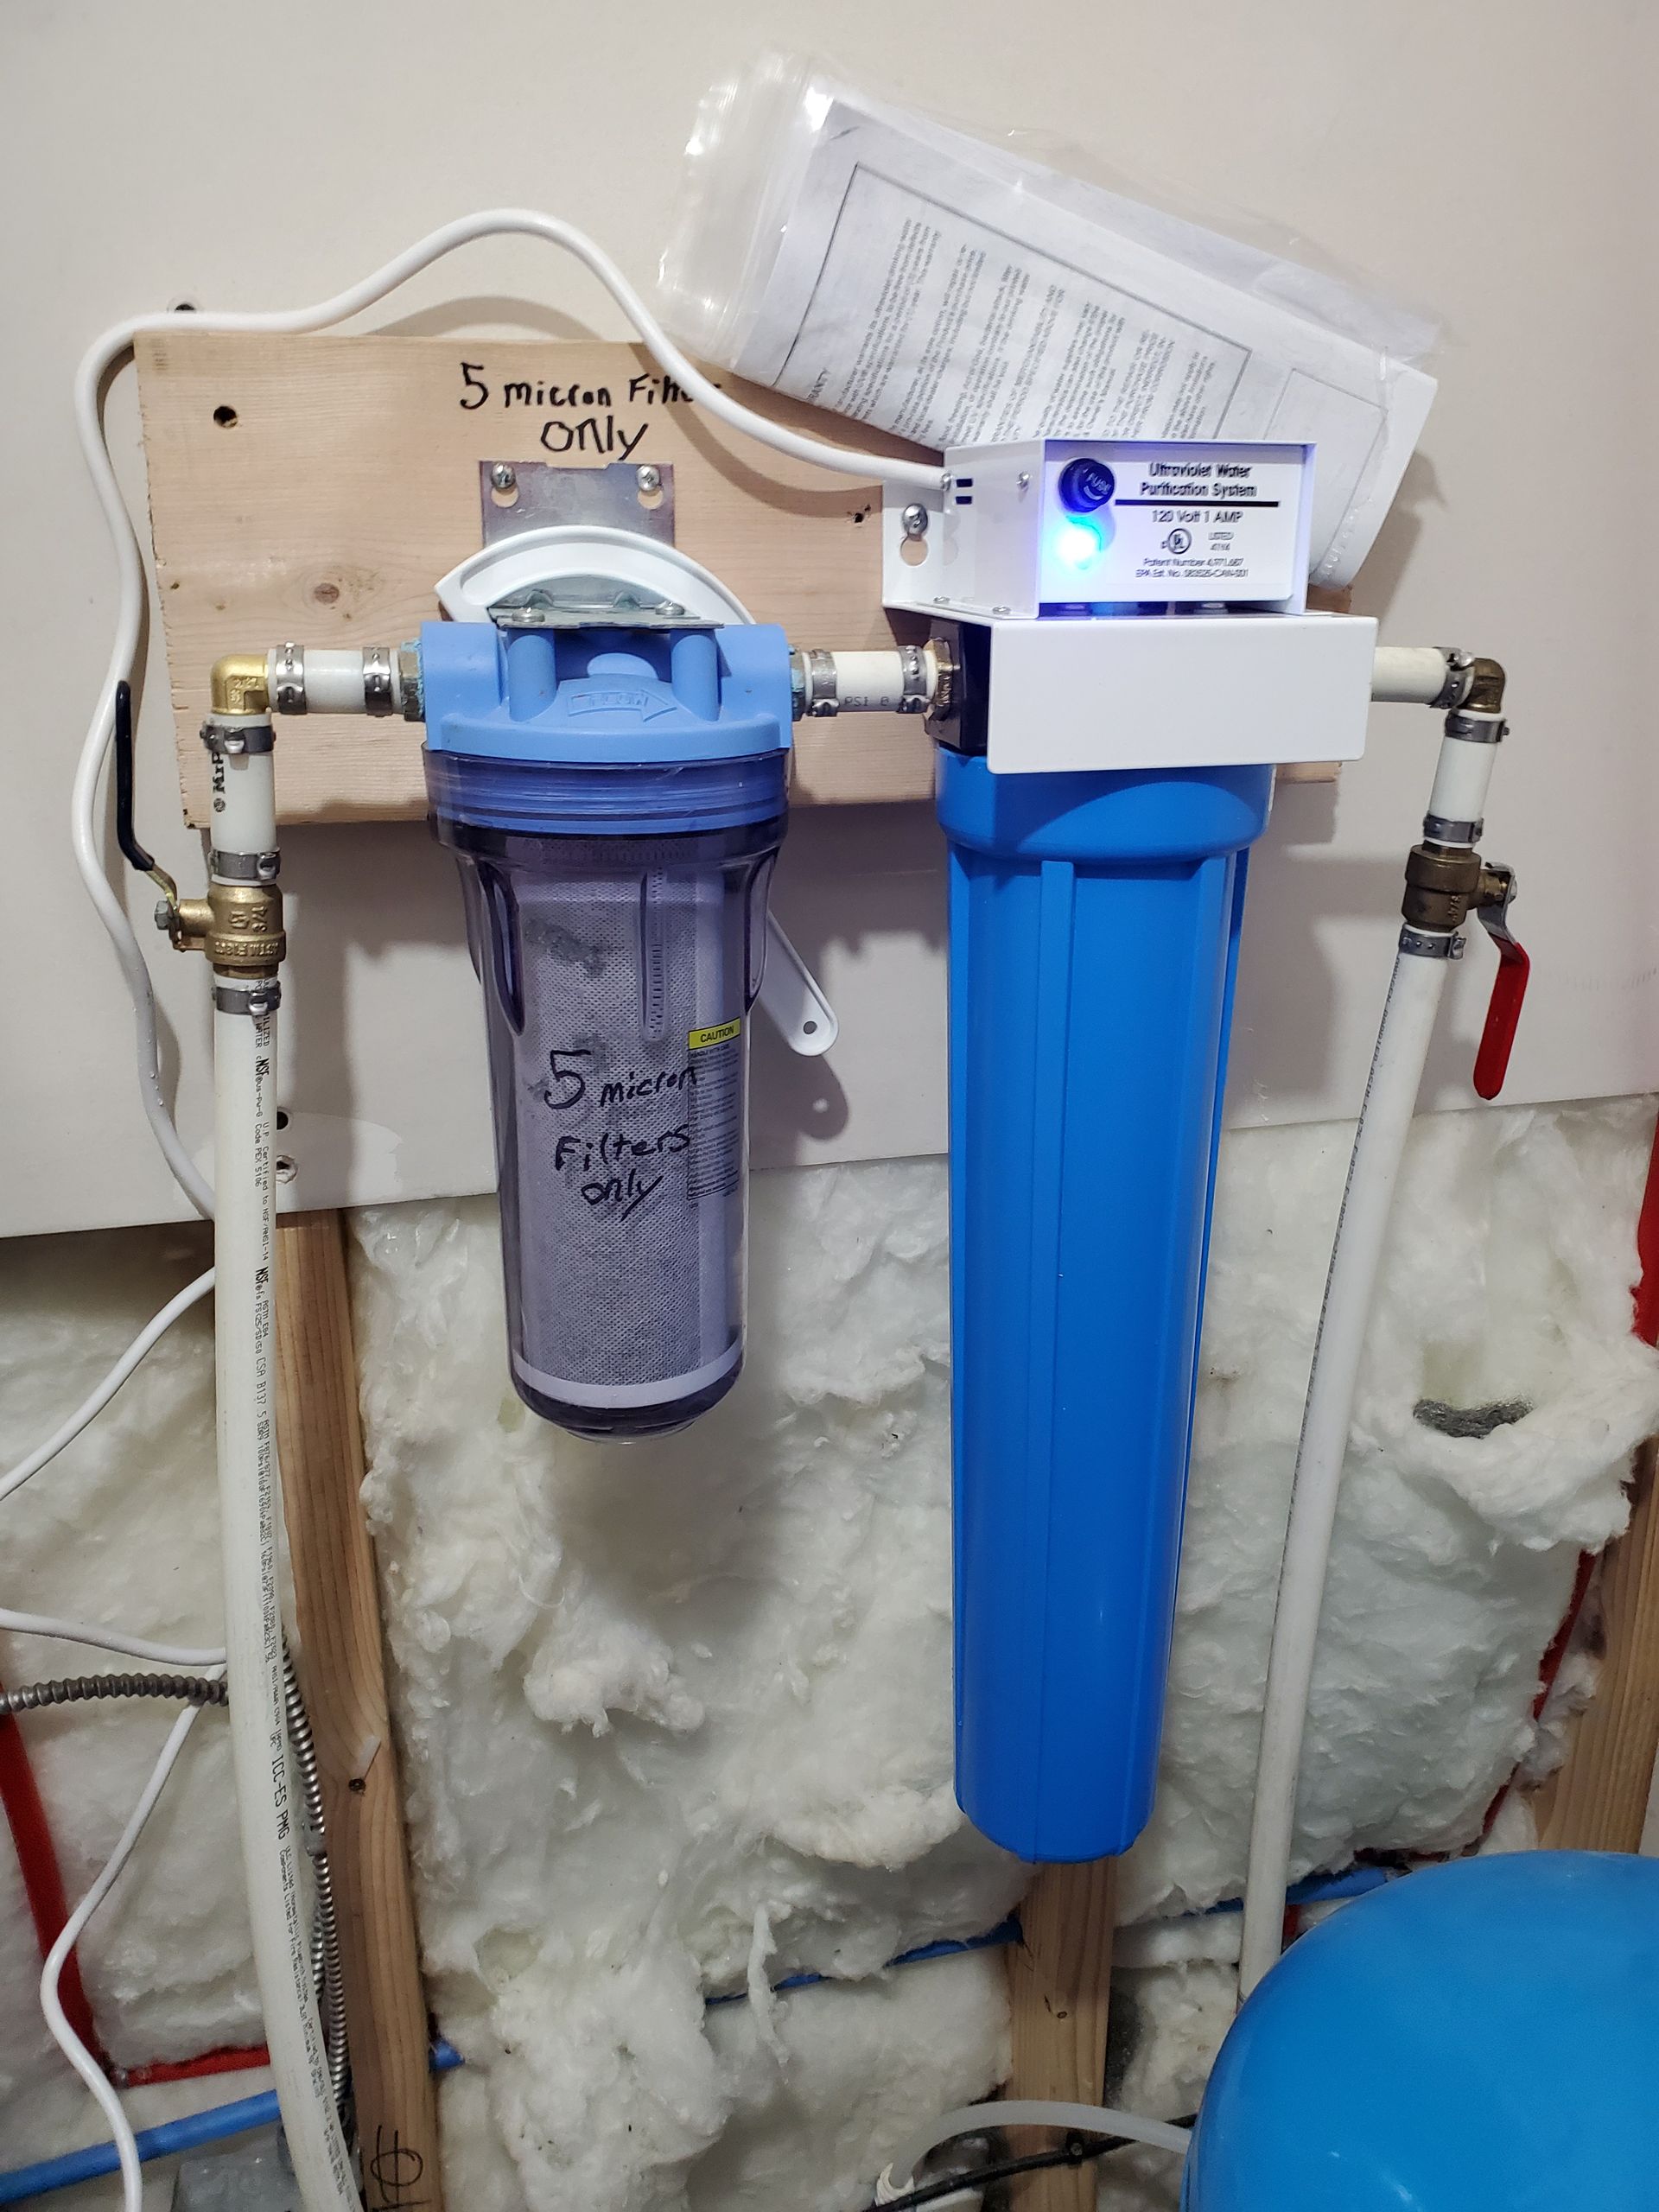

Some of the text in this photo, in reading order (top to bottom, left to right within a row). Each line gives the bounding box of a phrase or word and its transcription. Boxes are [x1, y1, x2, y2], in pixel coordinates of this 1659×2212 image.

[461, 363, 490, 410] 5
[505, 380, 611, 408] micron
[1148, 463, 1251, 478] Ultraviolet Water
[1141, 482, 1257, 499] Purification System
[1152, 510, 1243, 523] 120 Volt 1 AMP
[700, 1025, 734, 1044] CAUTION
[543, 1048, 697, 1109] 5 micron
[555, 1124, 690, 1171] Filters
[256, 1357, 265, 1376] CSA
[270, 1754, 291, 1840] ICC-ES PMG
